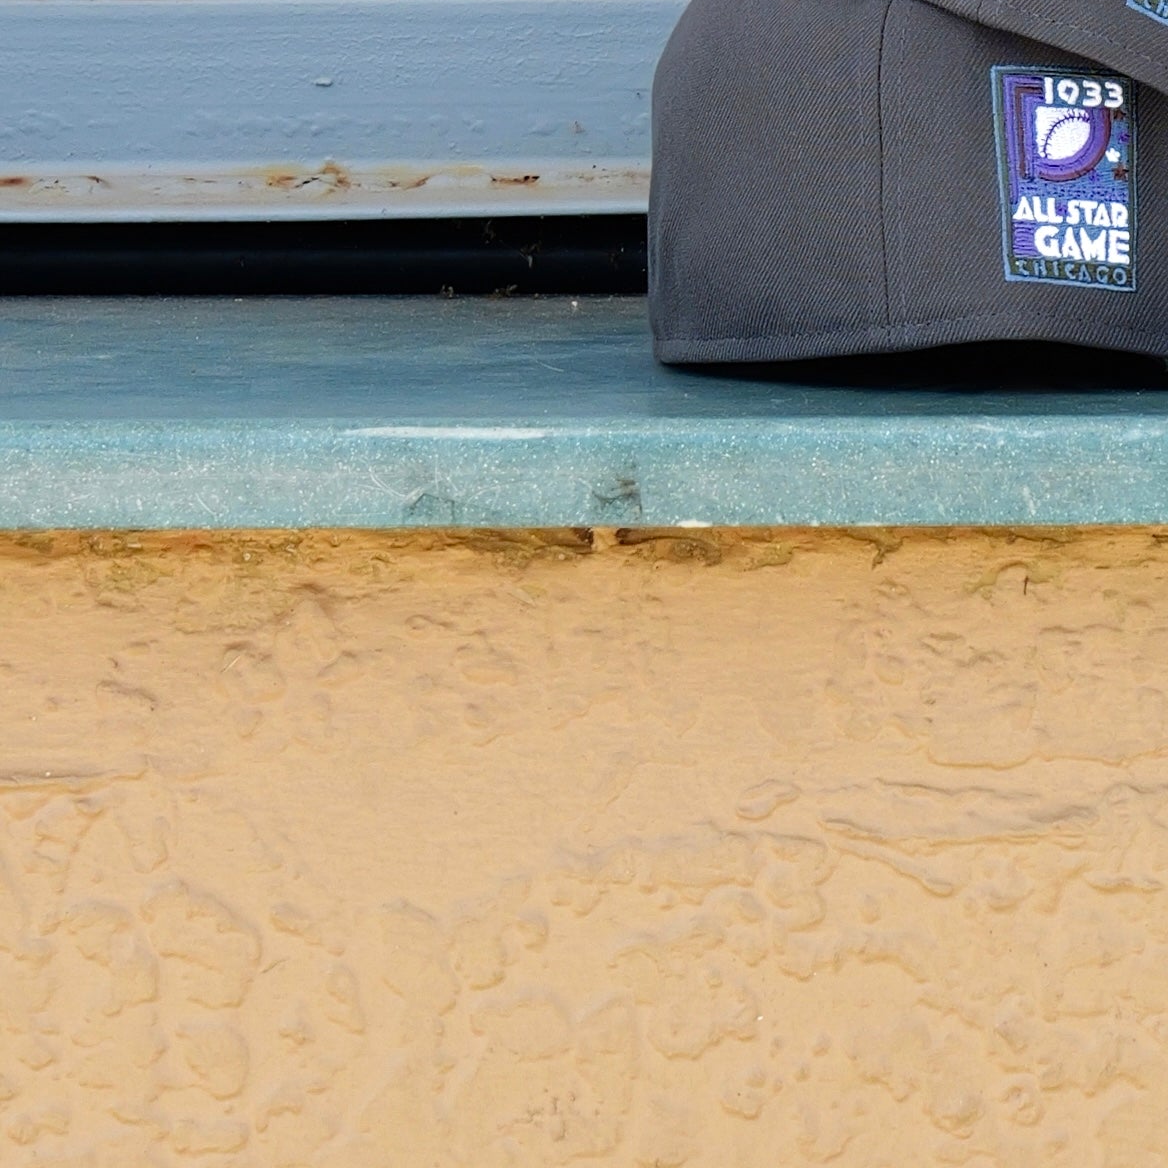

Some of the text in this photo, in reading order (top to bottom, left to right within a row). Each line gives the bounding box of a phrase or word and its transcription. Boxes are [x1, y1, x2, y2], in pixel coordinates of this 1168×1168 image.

[1044, 77, 1124, 108] 1933
[1013, 196, 1128, 227] ALL STAR
[1034, 225, 1130, 264] GAME
[1015, 260, 1127, 283] CHICAGO
